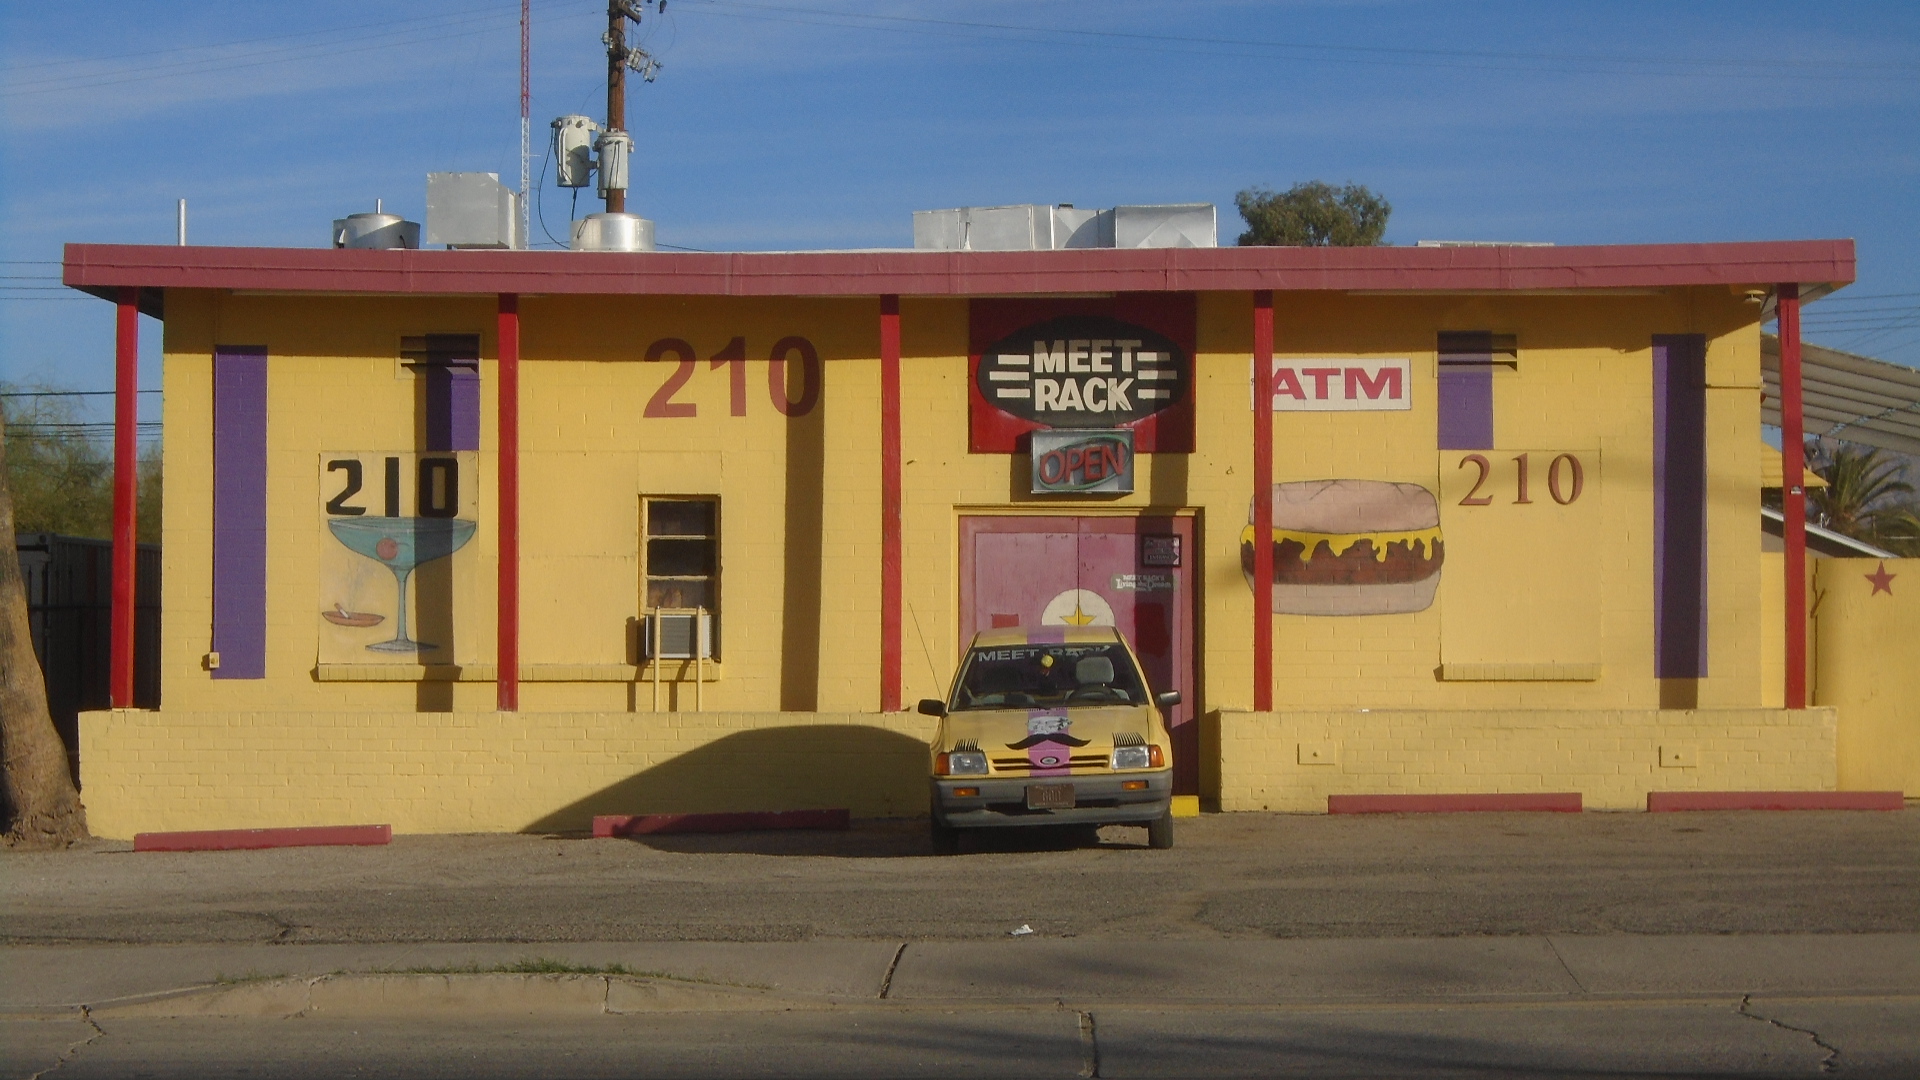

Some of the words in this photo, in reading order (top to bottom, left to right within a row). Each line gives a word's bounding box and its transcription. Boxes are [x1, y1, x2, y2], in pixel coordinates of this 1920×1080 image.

[1033, 339, 1142, 373] MEET
[643, 335, 821, 418] 210
[1034, 376, 1135, 413] RACK
[1272, 367, 1403, 400] ATM
[1039, 442, 1125, 485] OPEN
[1458, 452, 1584, 506] 210
[326, 456, 459, 518] 210
[978, 648, 1040, 662] MEET
